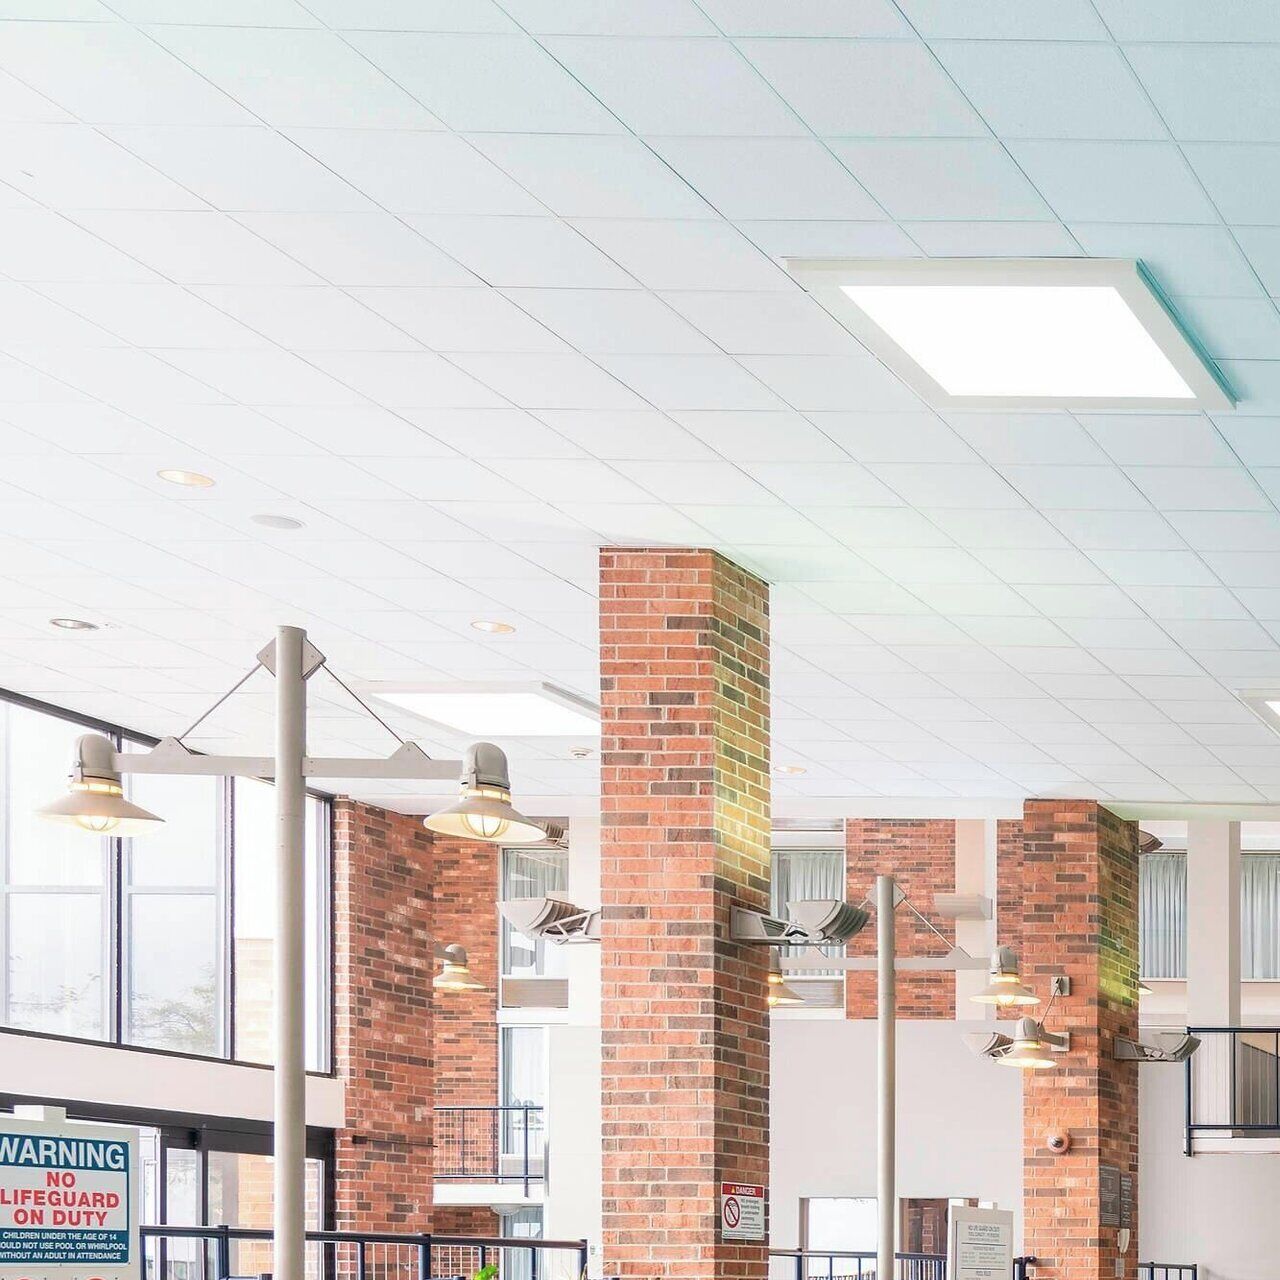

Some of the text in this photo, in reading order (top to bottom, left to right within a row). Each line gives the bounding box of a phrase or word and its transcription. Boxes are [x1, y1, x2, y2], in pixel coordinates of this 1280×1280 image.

[46, 1171, 76, 1188] NO
[0, 1188, 119, 1208] LIFEGUARD
[13, 1208, 107, 1226] ON DUTY
[2, 1231, 40, 1240] CHILDREN
[41, 1232, 67, 1240] UNDER
[68, 1232, 82, 1240] THE
[39, 1242, 54, 1250] USE
[55, 1242, 75, 1250] POOL
[87, 1242, 127, 1251] WHIRLPOOL
[44, 1251, 67, 1259] ADULT
[68, 1252, 76, 1260] IN
[76, 1252, 121, 1260] ATTENDANCE
